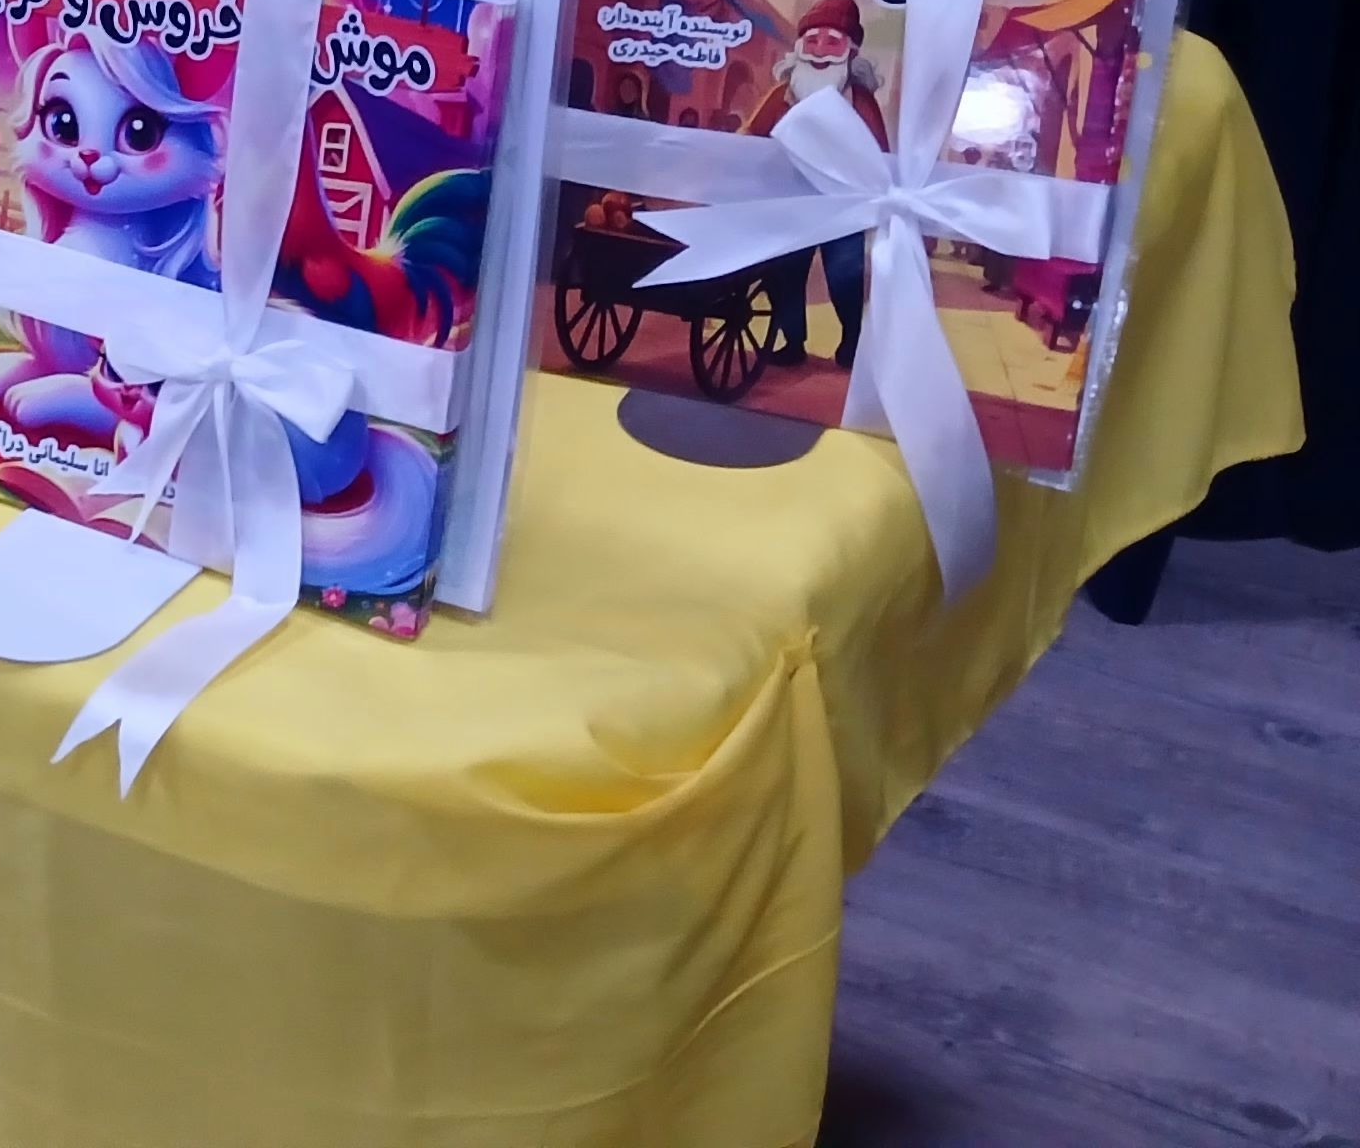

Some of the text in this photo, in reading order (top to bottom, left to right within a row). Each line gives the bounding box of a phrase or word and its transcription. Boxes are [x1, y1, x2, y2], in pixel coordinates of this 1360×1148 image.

[680, 20, 748, 43] نویسنده
[611, 42, 722, 65] فاطمه حیدری
[28, 444, 89, 472] سلیمانی
